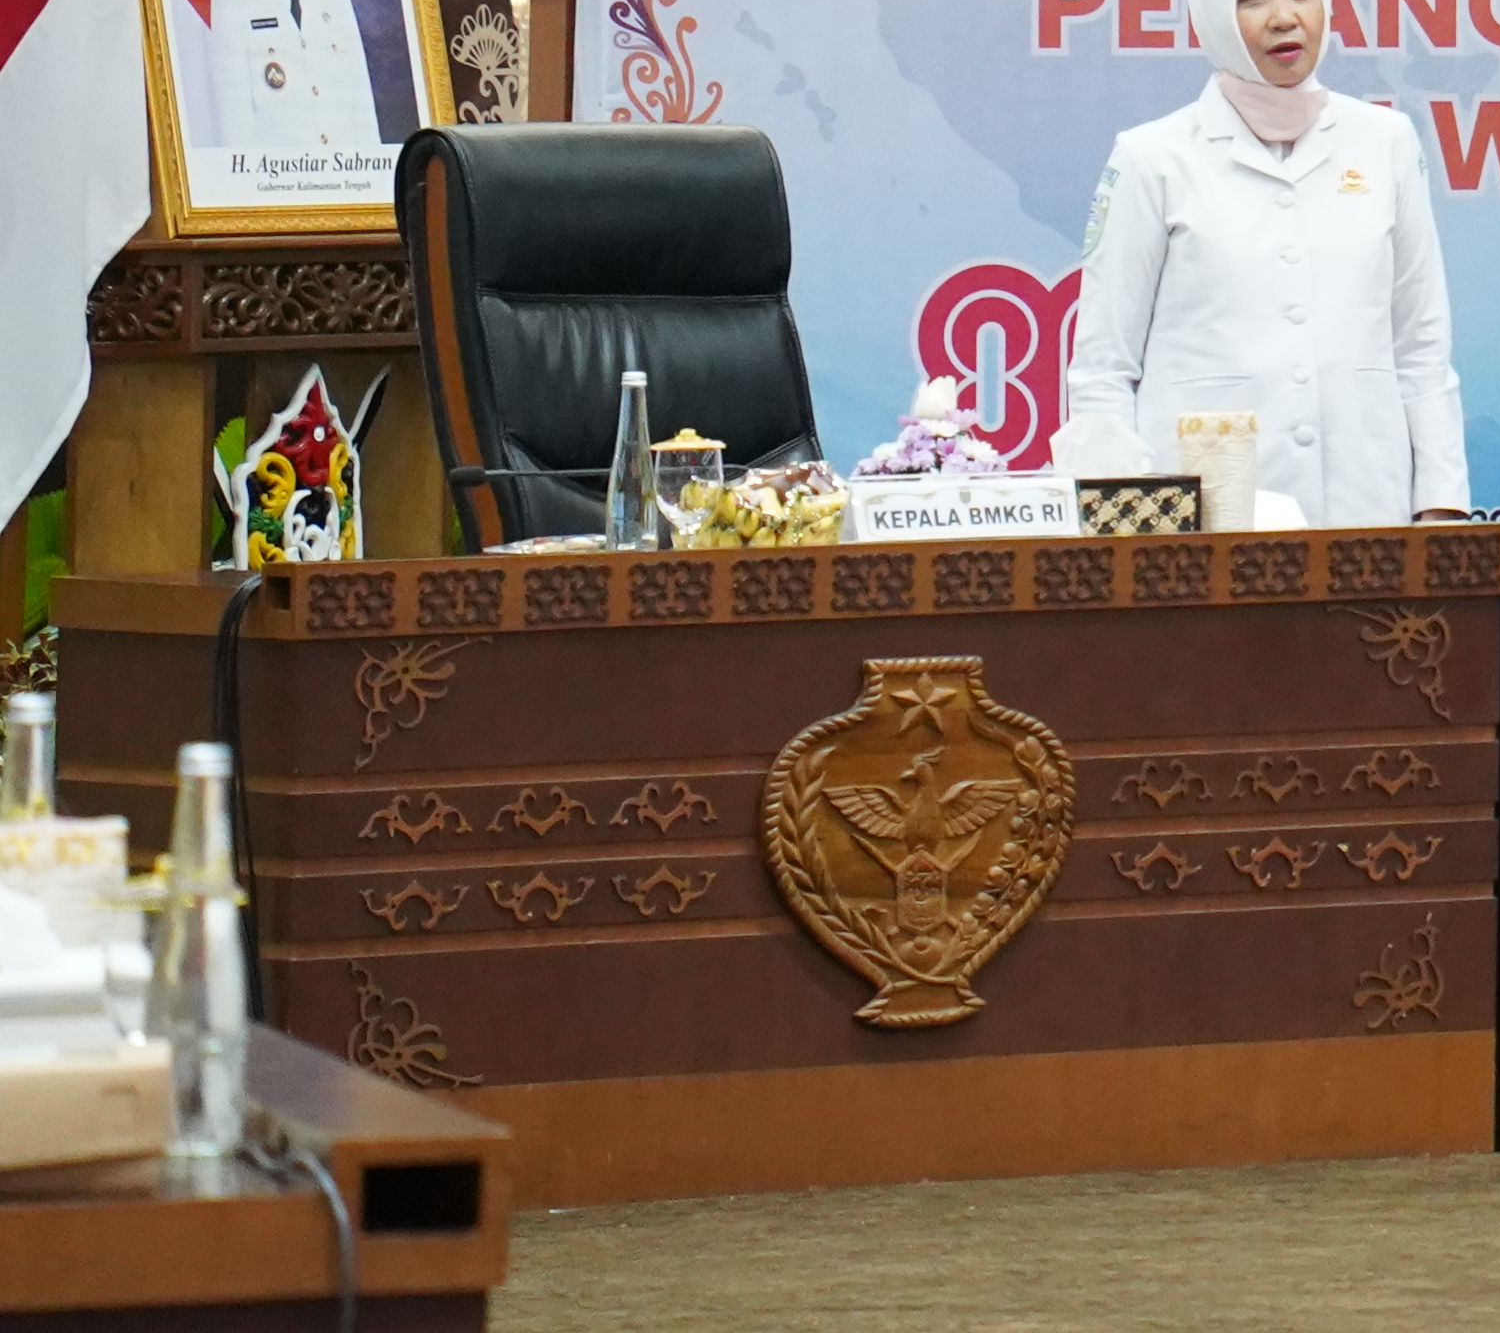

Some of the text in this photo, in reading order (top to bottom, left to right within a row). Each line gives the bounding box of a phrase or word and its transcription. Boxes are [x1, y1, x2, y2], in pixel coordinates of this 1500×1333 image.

[231, 152, 393, 179] H. Agustiar Sabran
[257, 181, 295, 192] Gubernur
[873, 503, 1064, 531] KEPALA BMKG RI
